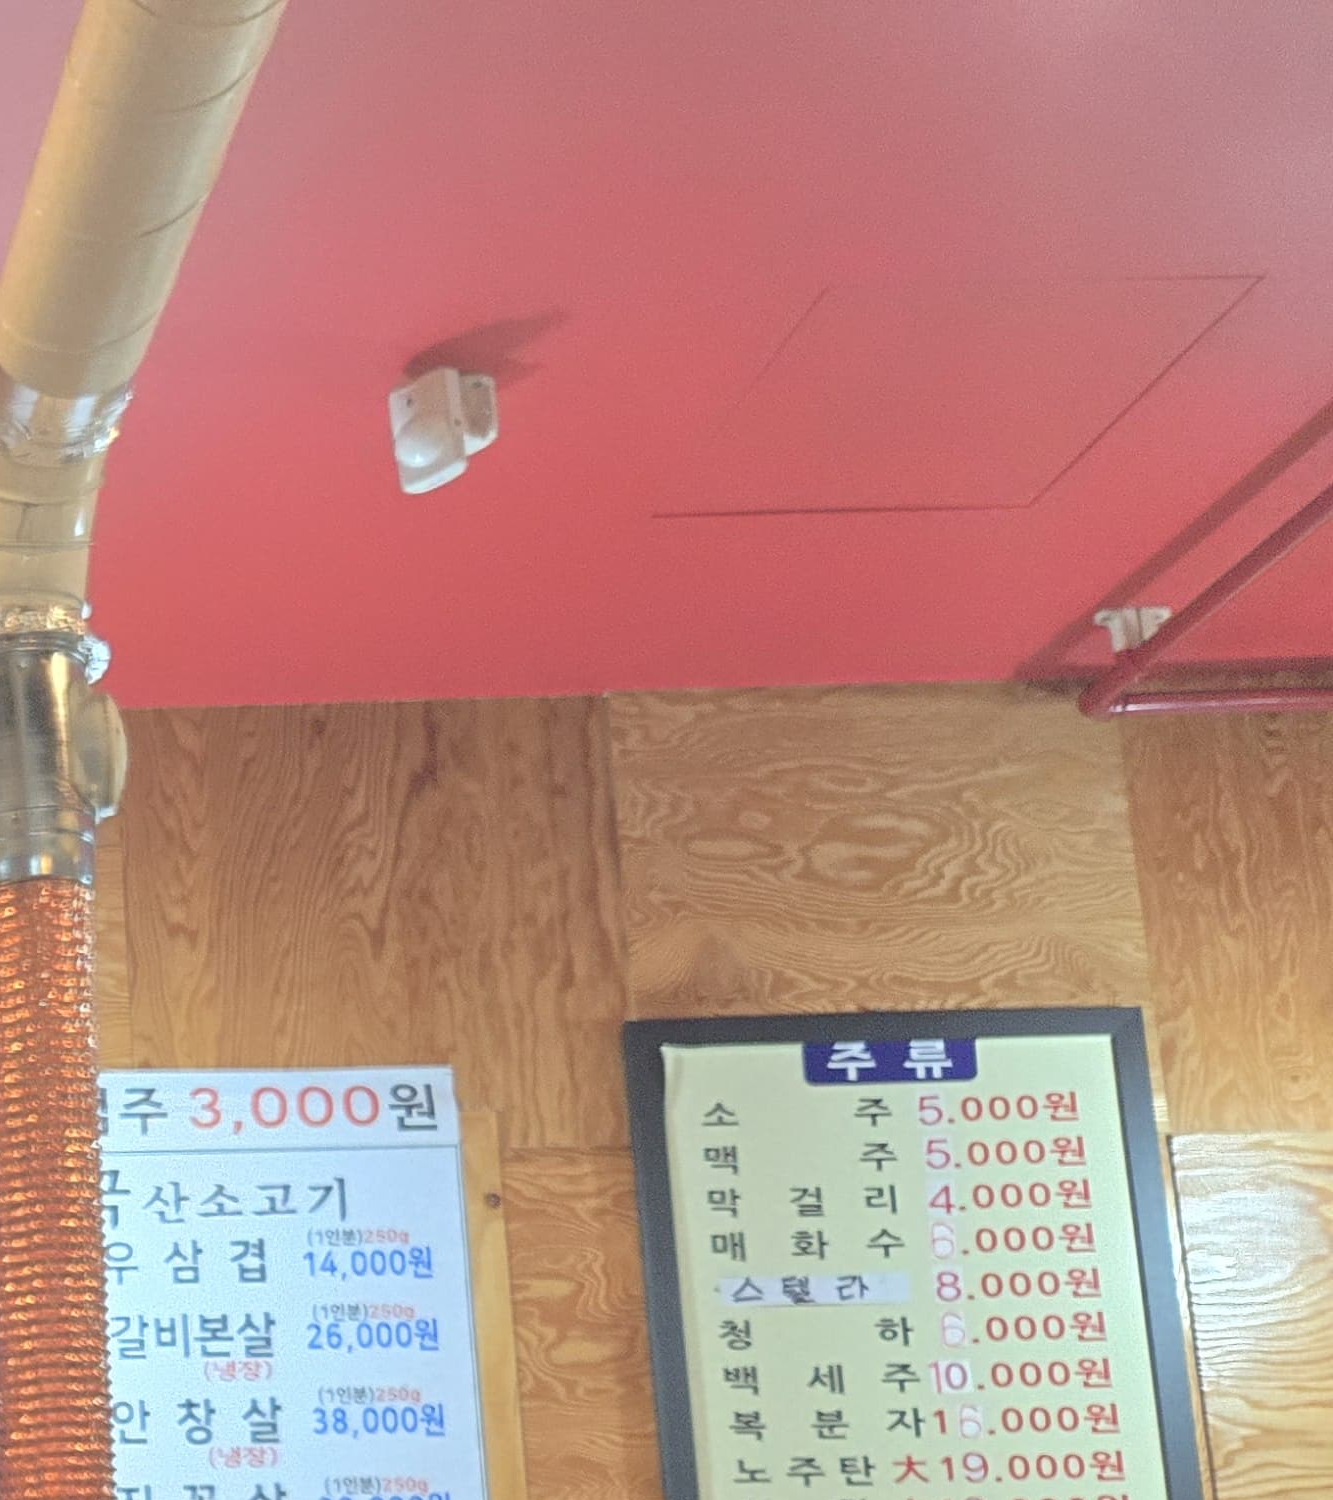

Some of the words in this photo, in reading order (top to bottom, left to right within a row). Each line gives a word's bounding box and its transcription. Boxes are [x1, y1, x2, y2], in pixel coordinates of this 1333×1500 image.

[99, 1086, 168, 1136] 주
[189, 1083, 438, 1135] 3,000원
[701, 1097, 893, 1128] 소주
[918, 1091, 1080, 1127] 5.000원
[703, 1141, 898, 1175] 맥주
[925, 1136, 1087, 1171] 5.000원
[707, 1184, 899, 1219] 막걸리
[928, 1179, 1093, 1216] 4.000원
[711, 1227, 906, 1262] 매화수
[303, 1246, 434, 1281] 14,000원
[935, 1267, 1103, 1303] 8.000원
[307, 1319, 439, 1354] 26,000원
[718, 1316, 914, 1351] 청하
[722, 1362, 921, 1397] 백세주
[312, 1402, 446, 1438] 38,000원
[729, 1407, 926, 1440] 복분자
